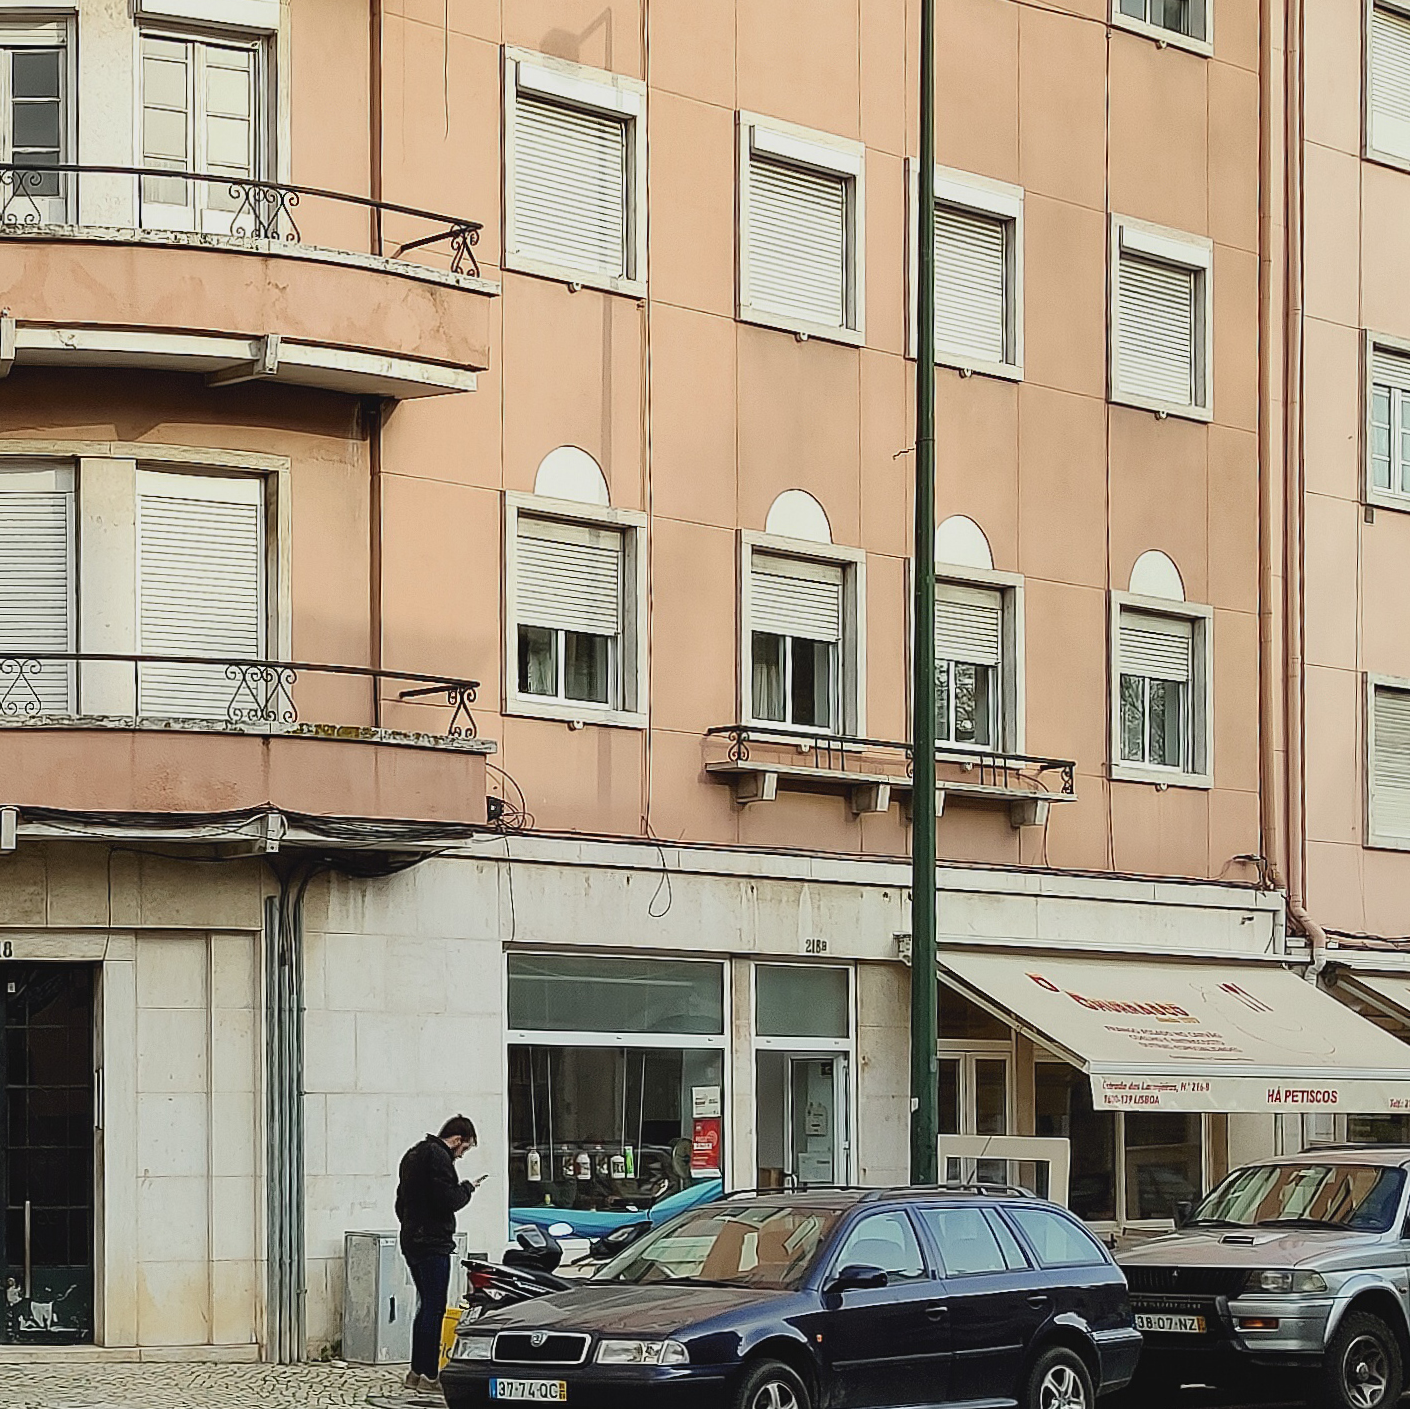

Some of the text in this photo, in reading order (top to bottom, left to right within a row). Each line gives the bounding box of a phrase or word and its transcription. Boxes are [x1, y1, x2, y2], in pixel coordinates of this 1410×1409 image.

[1133, 1095, 1160, 1104] LISBOA
[1267, 1086, 1338, 1103] HÁ PETISCOS
